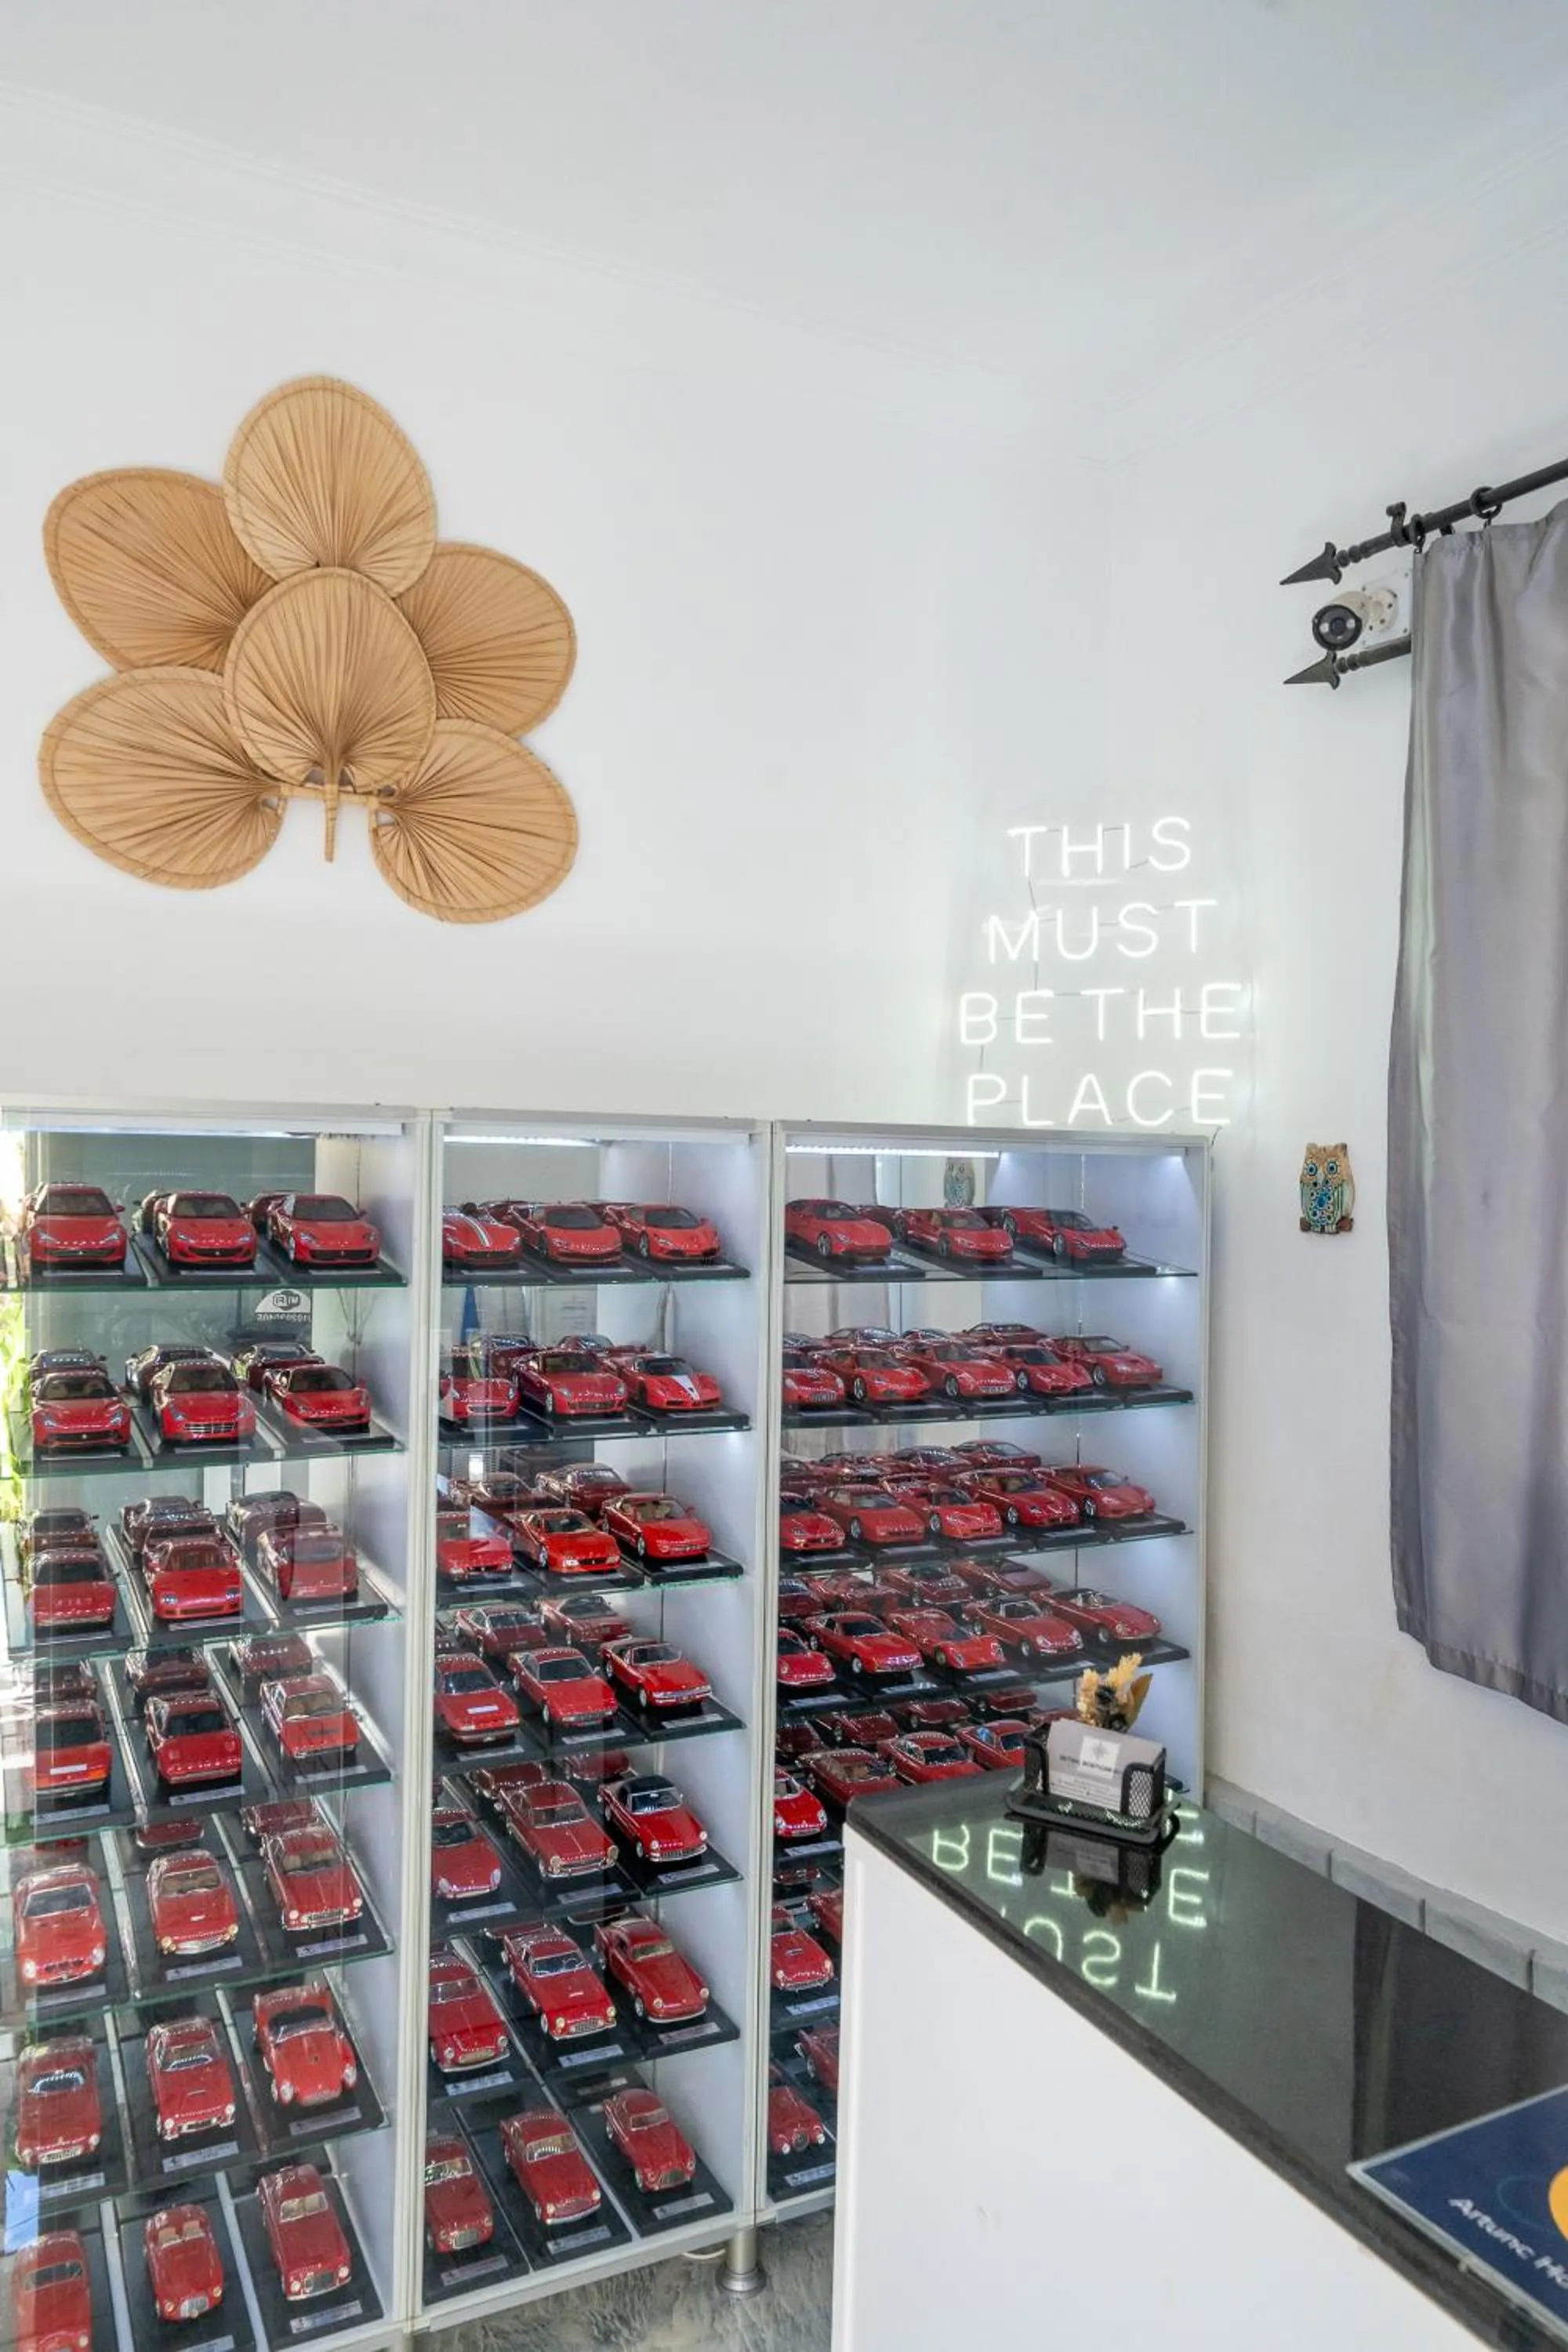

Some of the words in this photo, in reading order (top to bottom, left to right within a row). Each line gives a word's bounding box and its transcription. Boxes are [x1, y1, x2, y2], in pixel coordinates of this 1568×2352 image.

[1007, 817, 1191, 877] THIS
[988, 899, 1218, 964] MUST
[960, 990, 1054, 1044] BE
[1081, 983, 1242, 1041] THE
[967, 1069, 1233, 1127] PLACE
